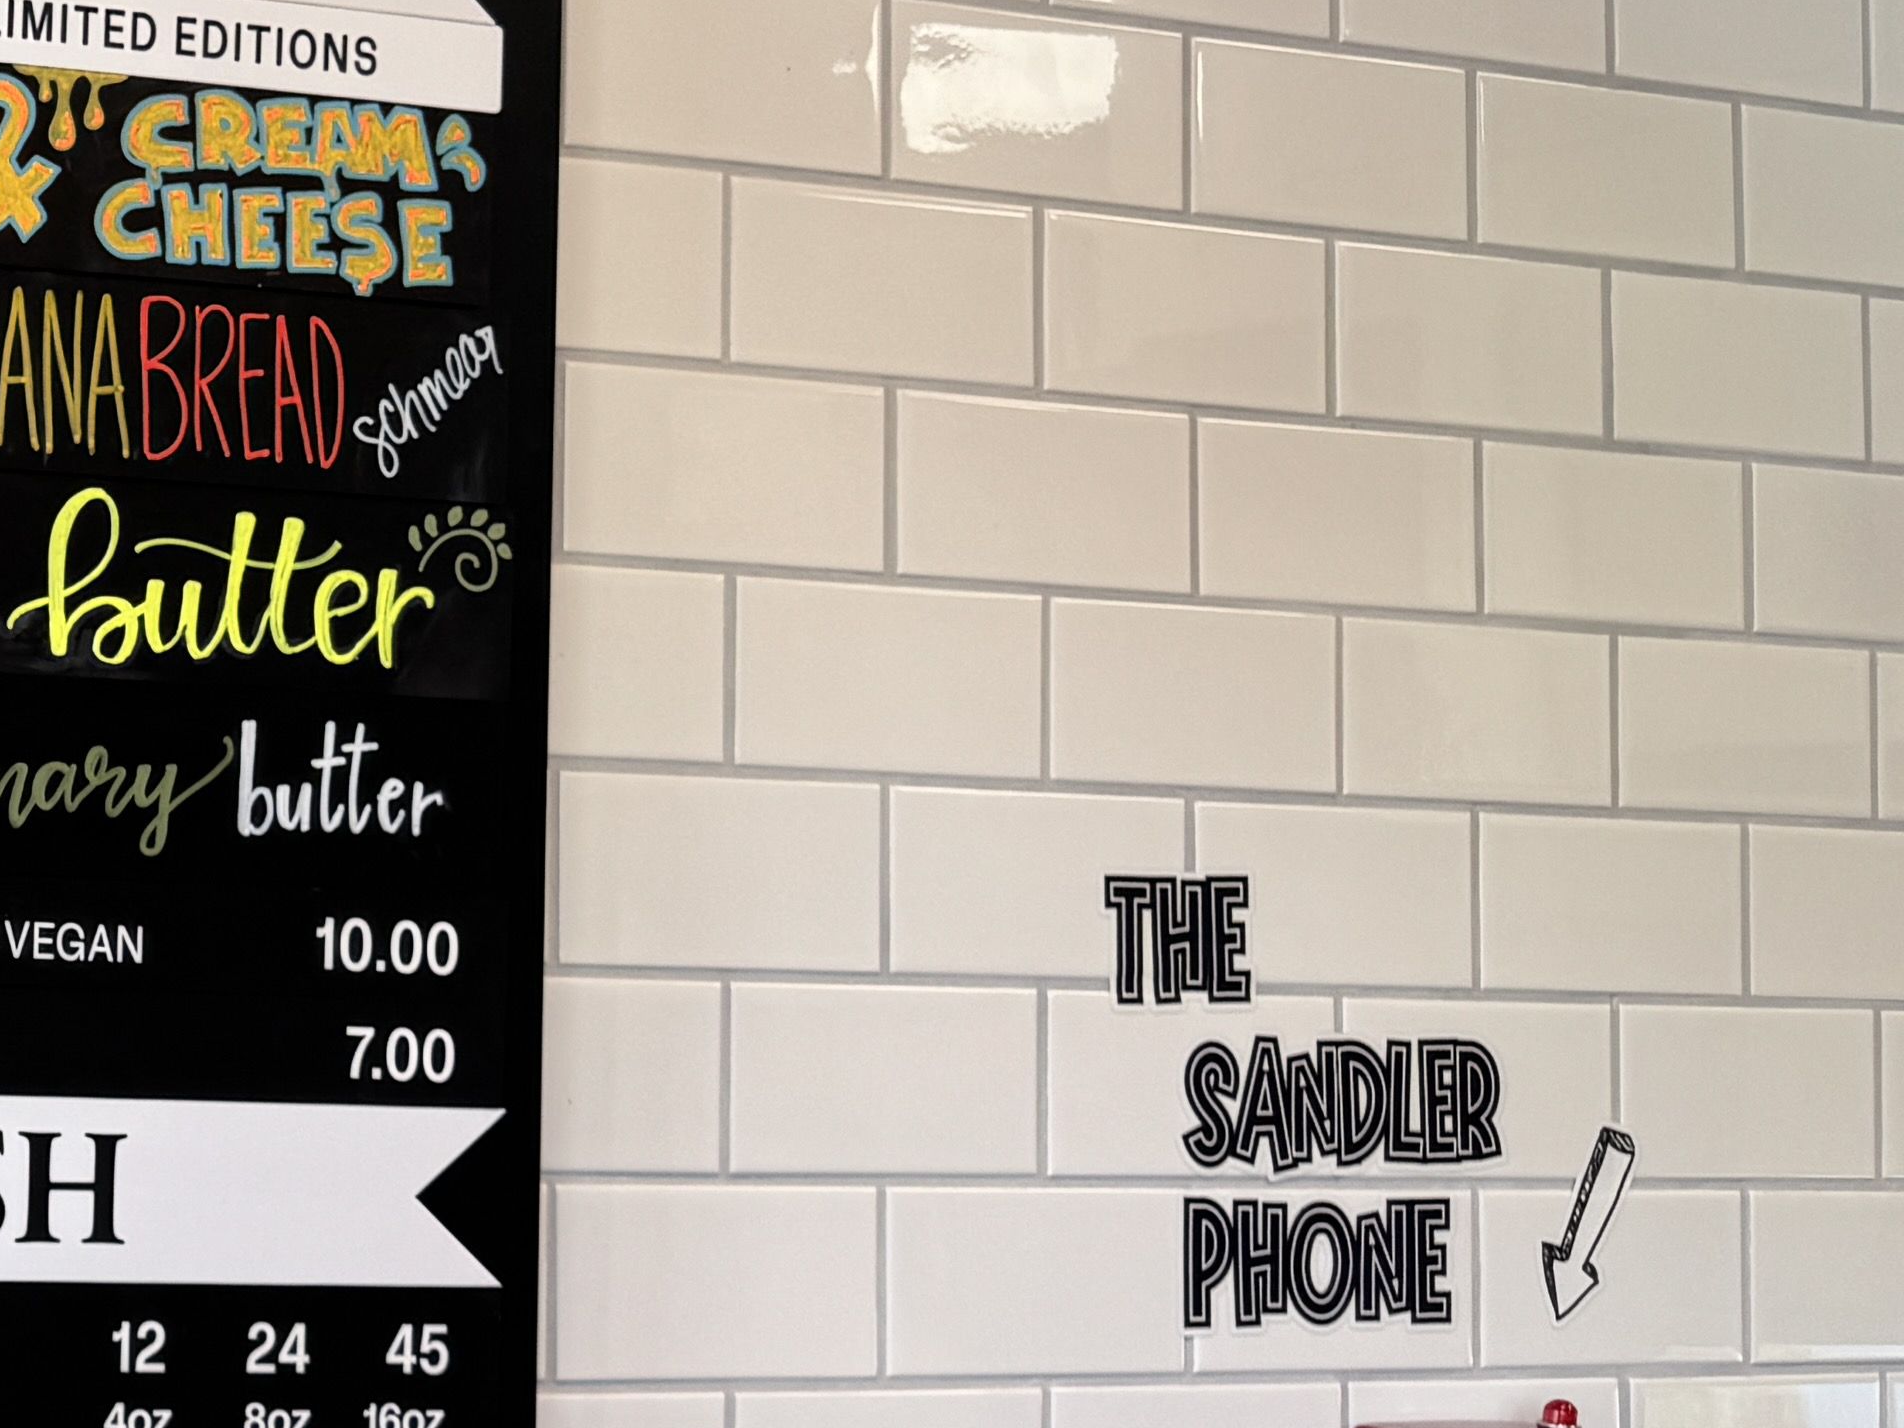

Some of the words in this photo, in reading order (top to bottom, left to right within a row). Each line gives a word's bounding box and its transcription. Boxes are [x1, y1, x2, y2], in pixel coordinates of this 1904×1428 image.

[175, 15, 377, 77] EDITIONS
[94, 177, 454, 296] CHEESE
[352, 324, 506, 480] schmear
[6, 484, 437, 669] butter
[235, 718, 444, 838] butter
[4, 919, 144, 964] VEGAN
[316, 916, 459, 976] 10.00
[1104, 875, 1251, 1006] THE
[346, 1025, 455, 1084] 7.00
[1181, 1036, 1503, 1175] SANDLER
[1183, 1197, 1453, 1329] PHONE
[112, 1320, 166, 1374] 12
[245, 1321, 310, 1374] 24
[385, 1323, 449, 1376] 45
